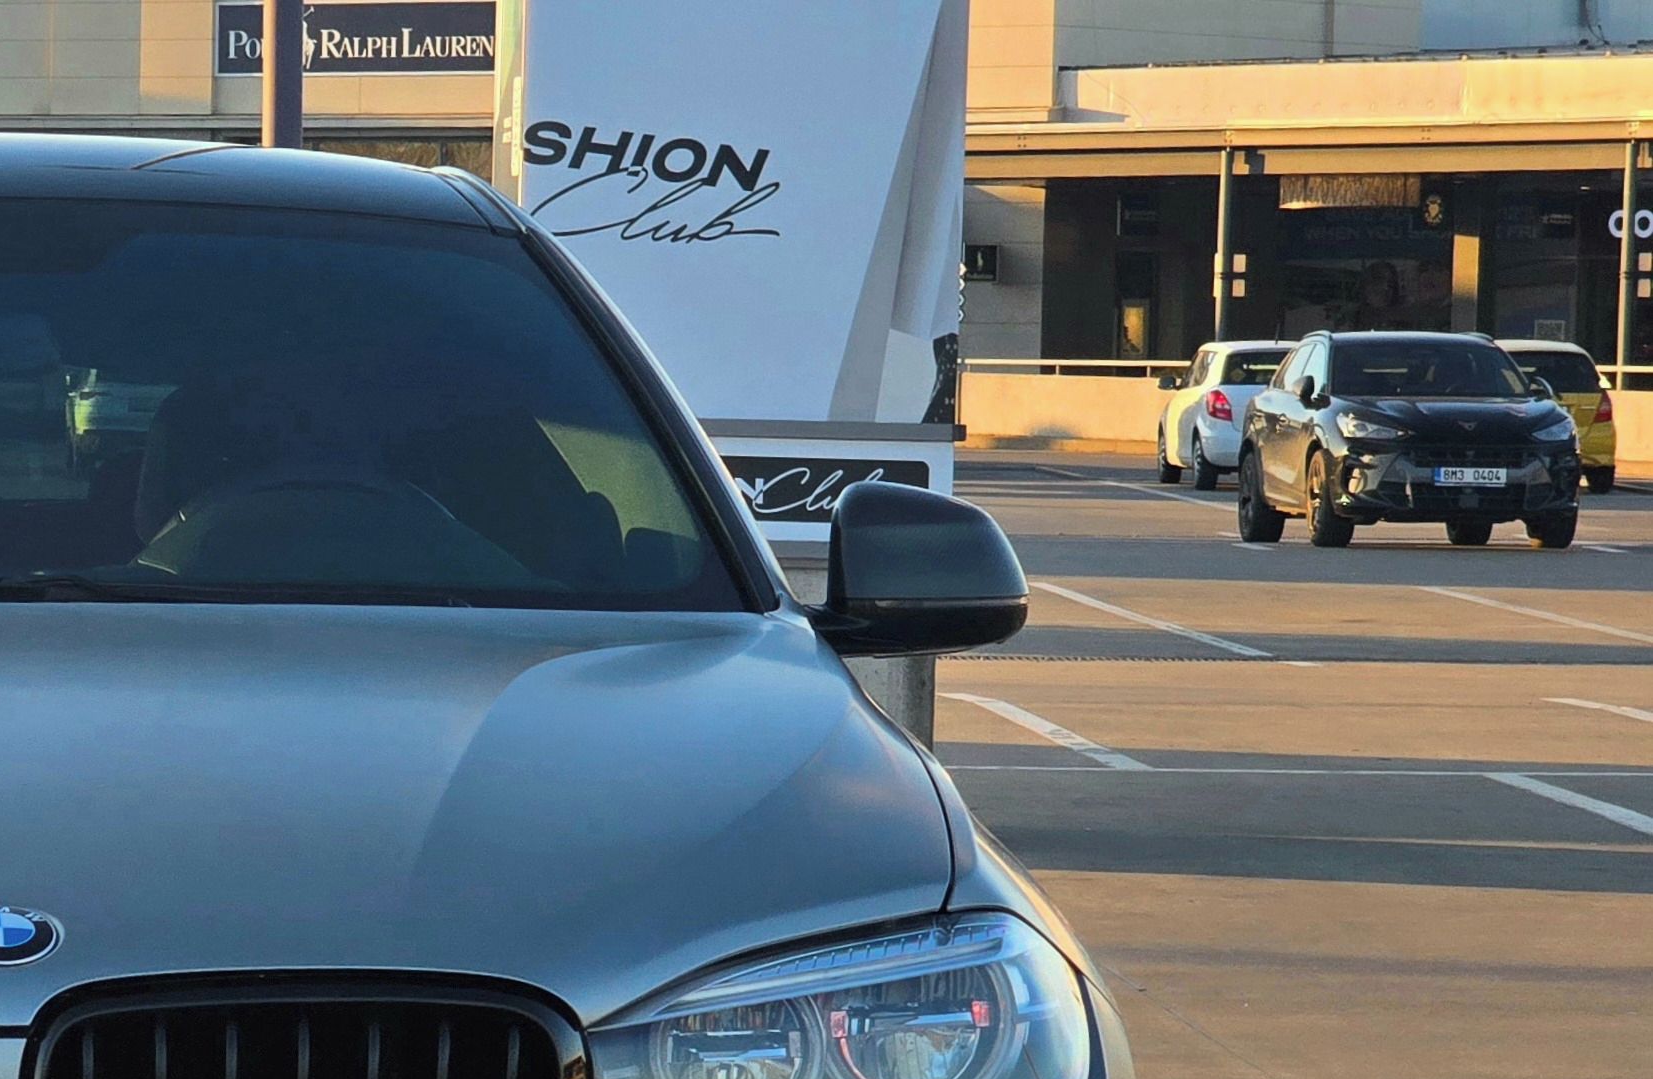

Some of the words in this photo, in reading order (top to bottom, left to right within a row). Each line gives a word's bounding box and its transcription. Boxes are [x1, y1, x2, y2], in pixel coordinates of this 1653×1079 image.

[319, 28, 397, 60] RALPH
[400, 27, 495, 58] LAUREN
[522, 120, 771, 192] SHION
[530, 165, 781, 244] Club
[1443, 469, 1465, 482] 8M3
[1473, 469, 1502, 482] 0404
